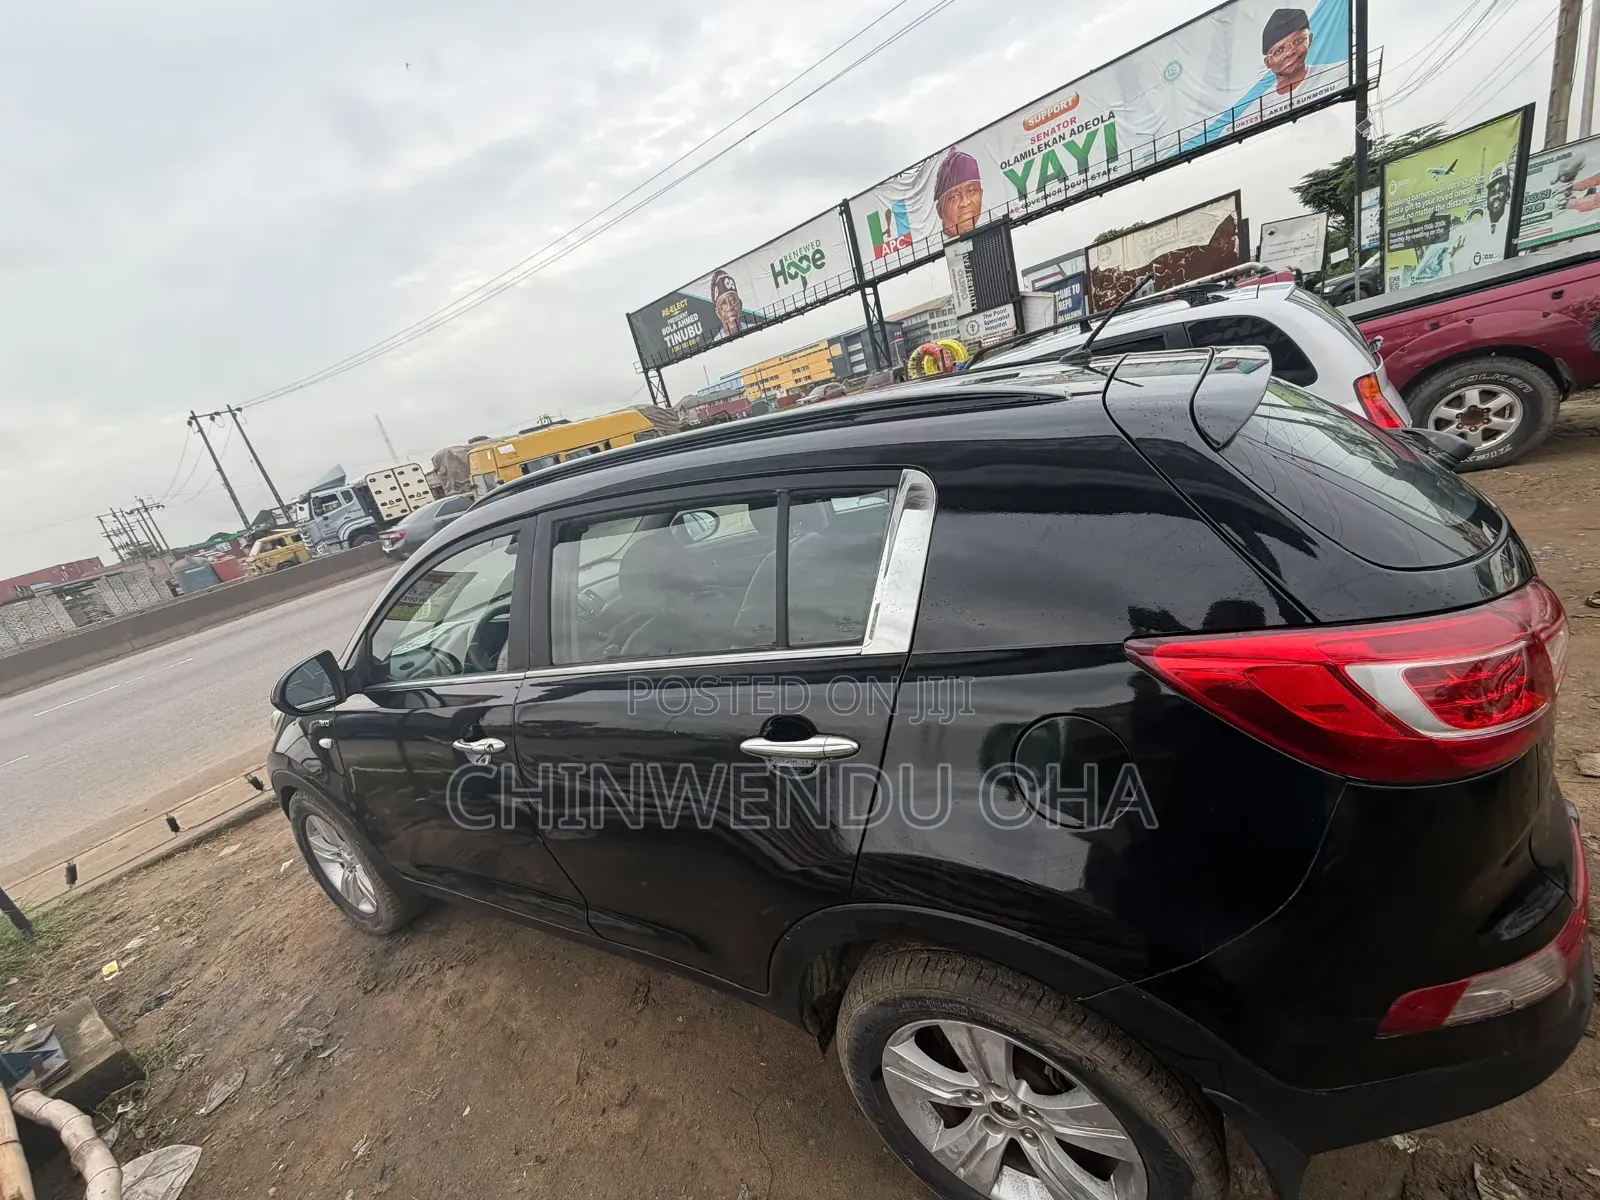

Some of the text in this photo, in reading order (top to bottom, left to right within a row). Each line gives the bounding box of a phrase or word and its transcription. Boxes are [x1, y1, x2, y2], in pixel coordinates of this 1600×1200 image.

[1028, 98, 1074, 126] SUPPORT
[1000, 110, 1116, 170] OLAMILEKAN ADEOLA
[1030, 116, 1077, 144] SENATOR
[1003, 121, 1118, 201] YAYI
[1021, 186, 1062, 210] GOVERNOR
[1065, 176, 1088, 192] OGUN
[1090, 165, 1118, 181] STATE
[1388, 196, 1411, 208] Breaking
[1388, 208, 1400, 216] send
[1404, 202, 1414, 214] gift
[1422, 198, 1436, 210] your
[1454, 188, 1470, 197] ones
[1415, 206, 1434, 218] matter
[1435, 203, 1446, 212] the
[784, 239, 821, 262] RENEWED
[882, 237, 907, 257] APC
[966, 271, 978, 310] FERTILITY
[1072, 282, 1080, 295] TO
[662, 298, 688, 318] RE-ELECT
[993, 308, 1007, 316] Point
[662, 312, 698, 336] BOLA AHMED
[984, 314, 1010, 326] Specialist
[984, 320, 1008, 332] Hospital
[664, 321, 702, 348] TINUBU
